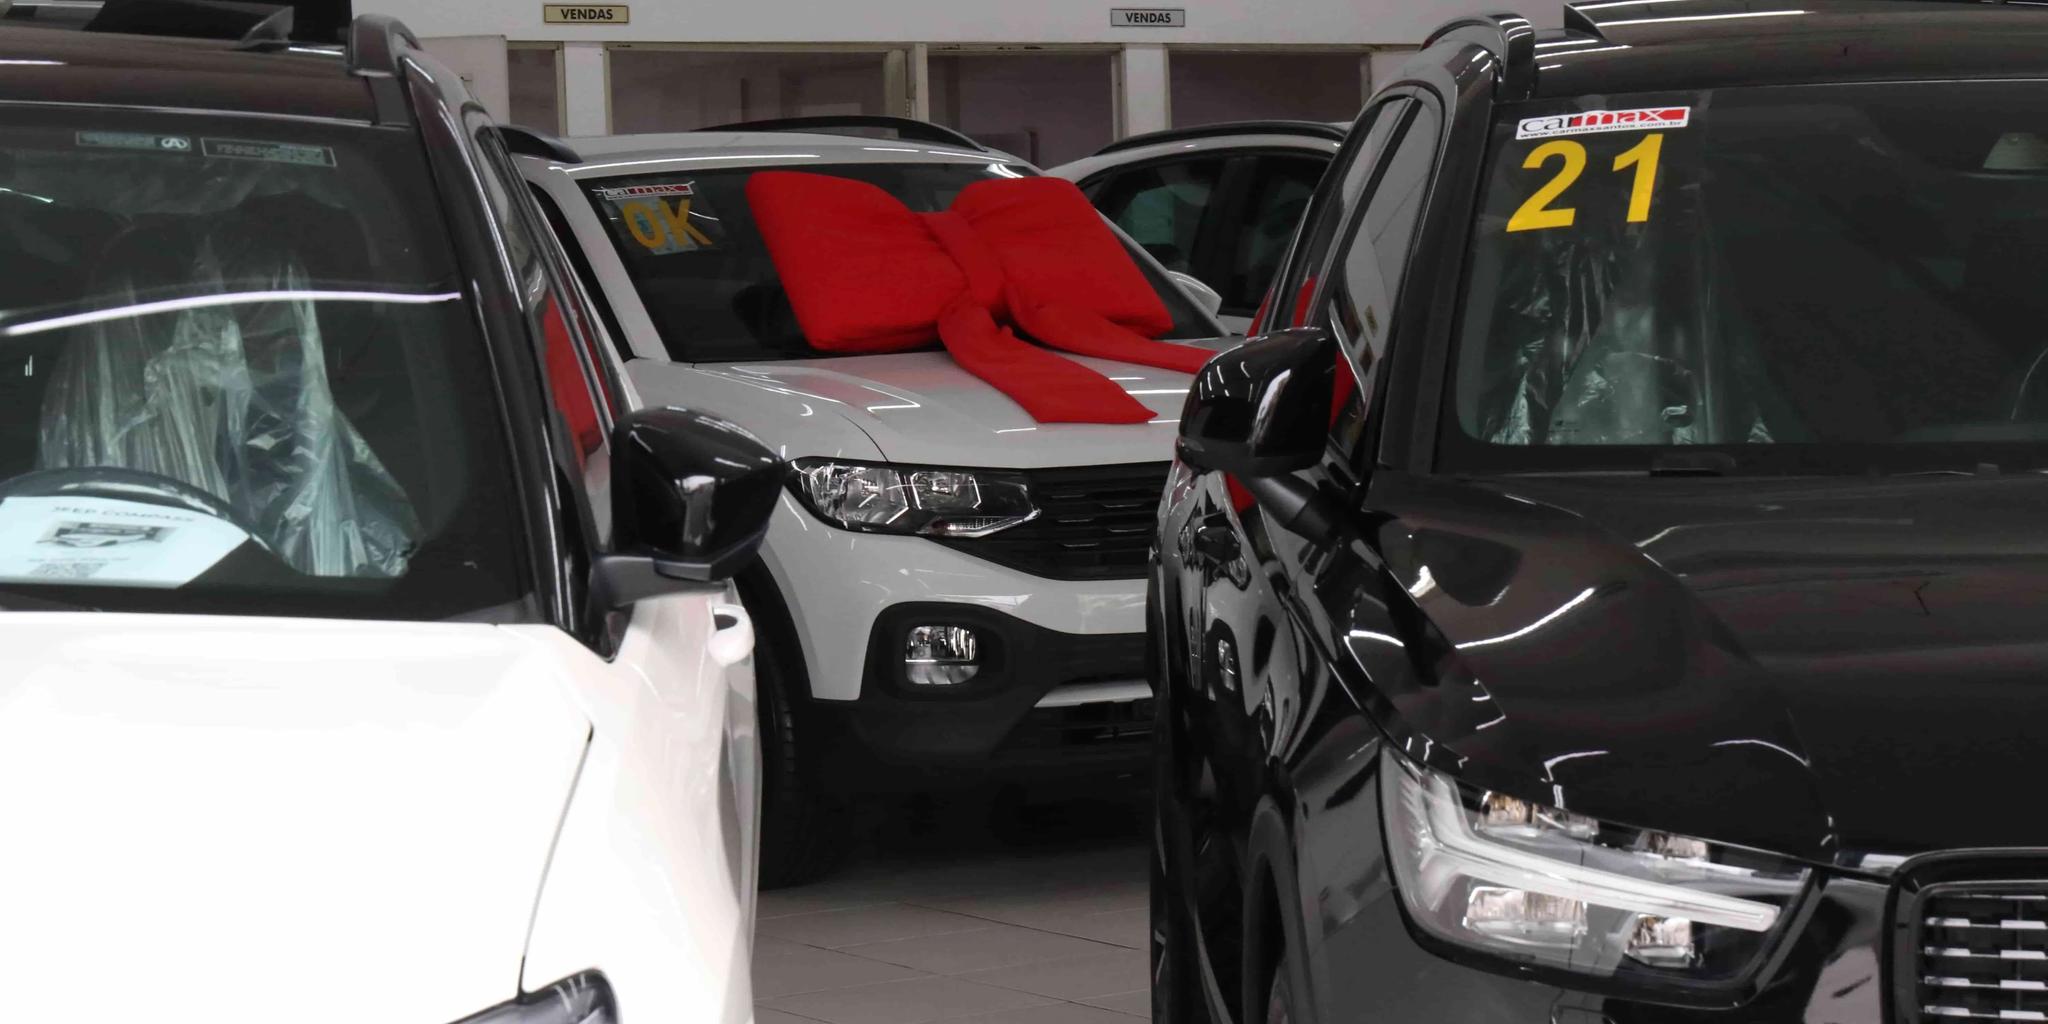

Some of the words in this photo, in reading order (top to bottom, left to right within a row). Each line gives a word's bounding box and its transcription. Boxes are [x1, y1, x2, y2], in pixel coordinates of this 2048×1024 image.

[561, 8, 613, 20] VENDAS
[1125, 13, 1172, 24] VENDAS
[1521, 109, 1664, 132] carmax
[1519, 121, 1683, 138] www.carmaxsantos.com.br
